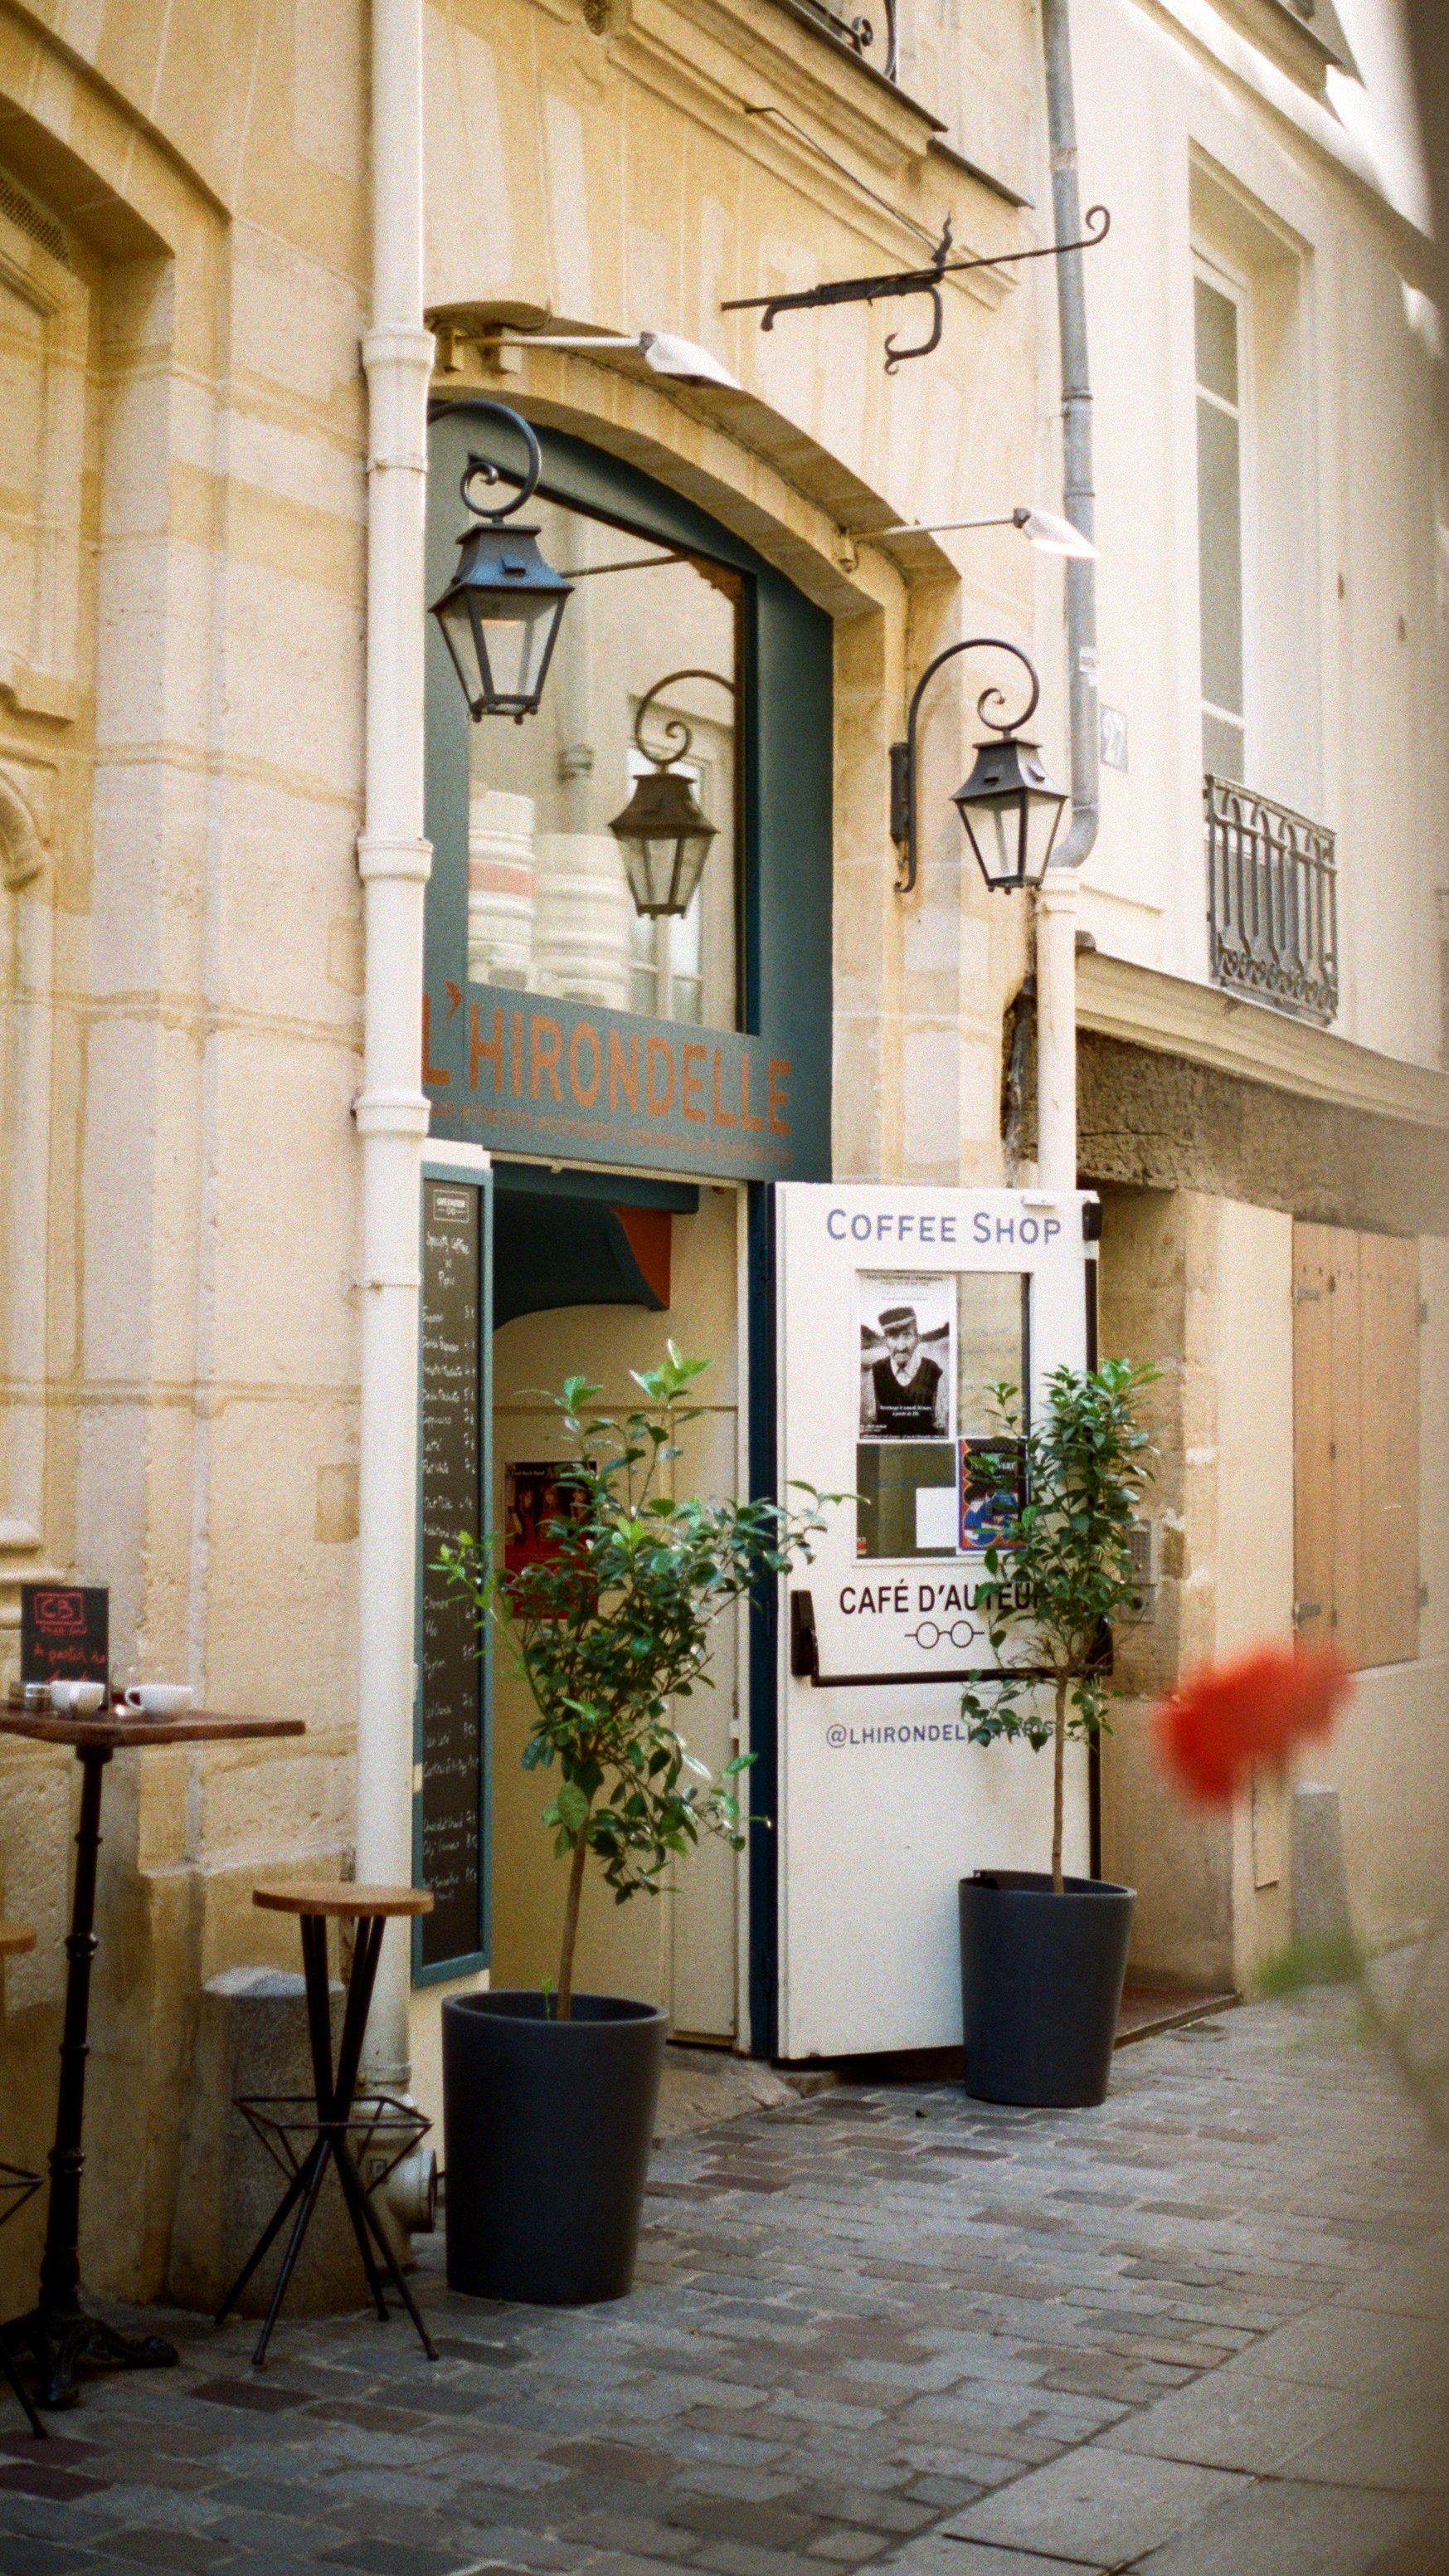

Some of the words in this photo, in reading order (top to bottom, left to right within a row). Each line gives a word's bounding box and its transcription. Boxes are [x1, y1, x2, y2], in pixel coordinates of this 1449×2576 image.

[422, 981, 791, 1135] L'HIRONDELLE
[827, 1209, 956, 1242] COFFEE
[973, 1211, 1062, 1244] SHOP
[839, 1579, 909, 1614] CAFÉ
